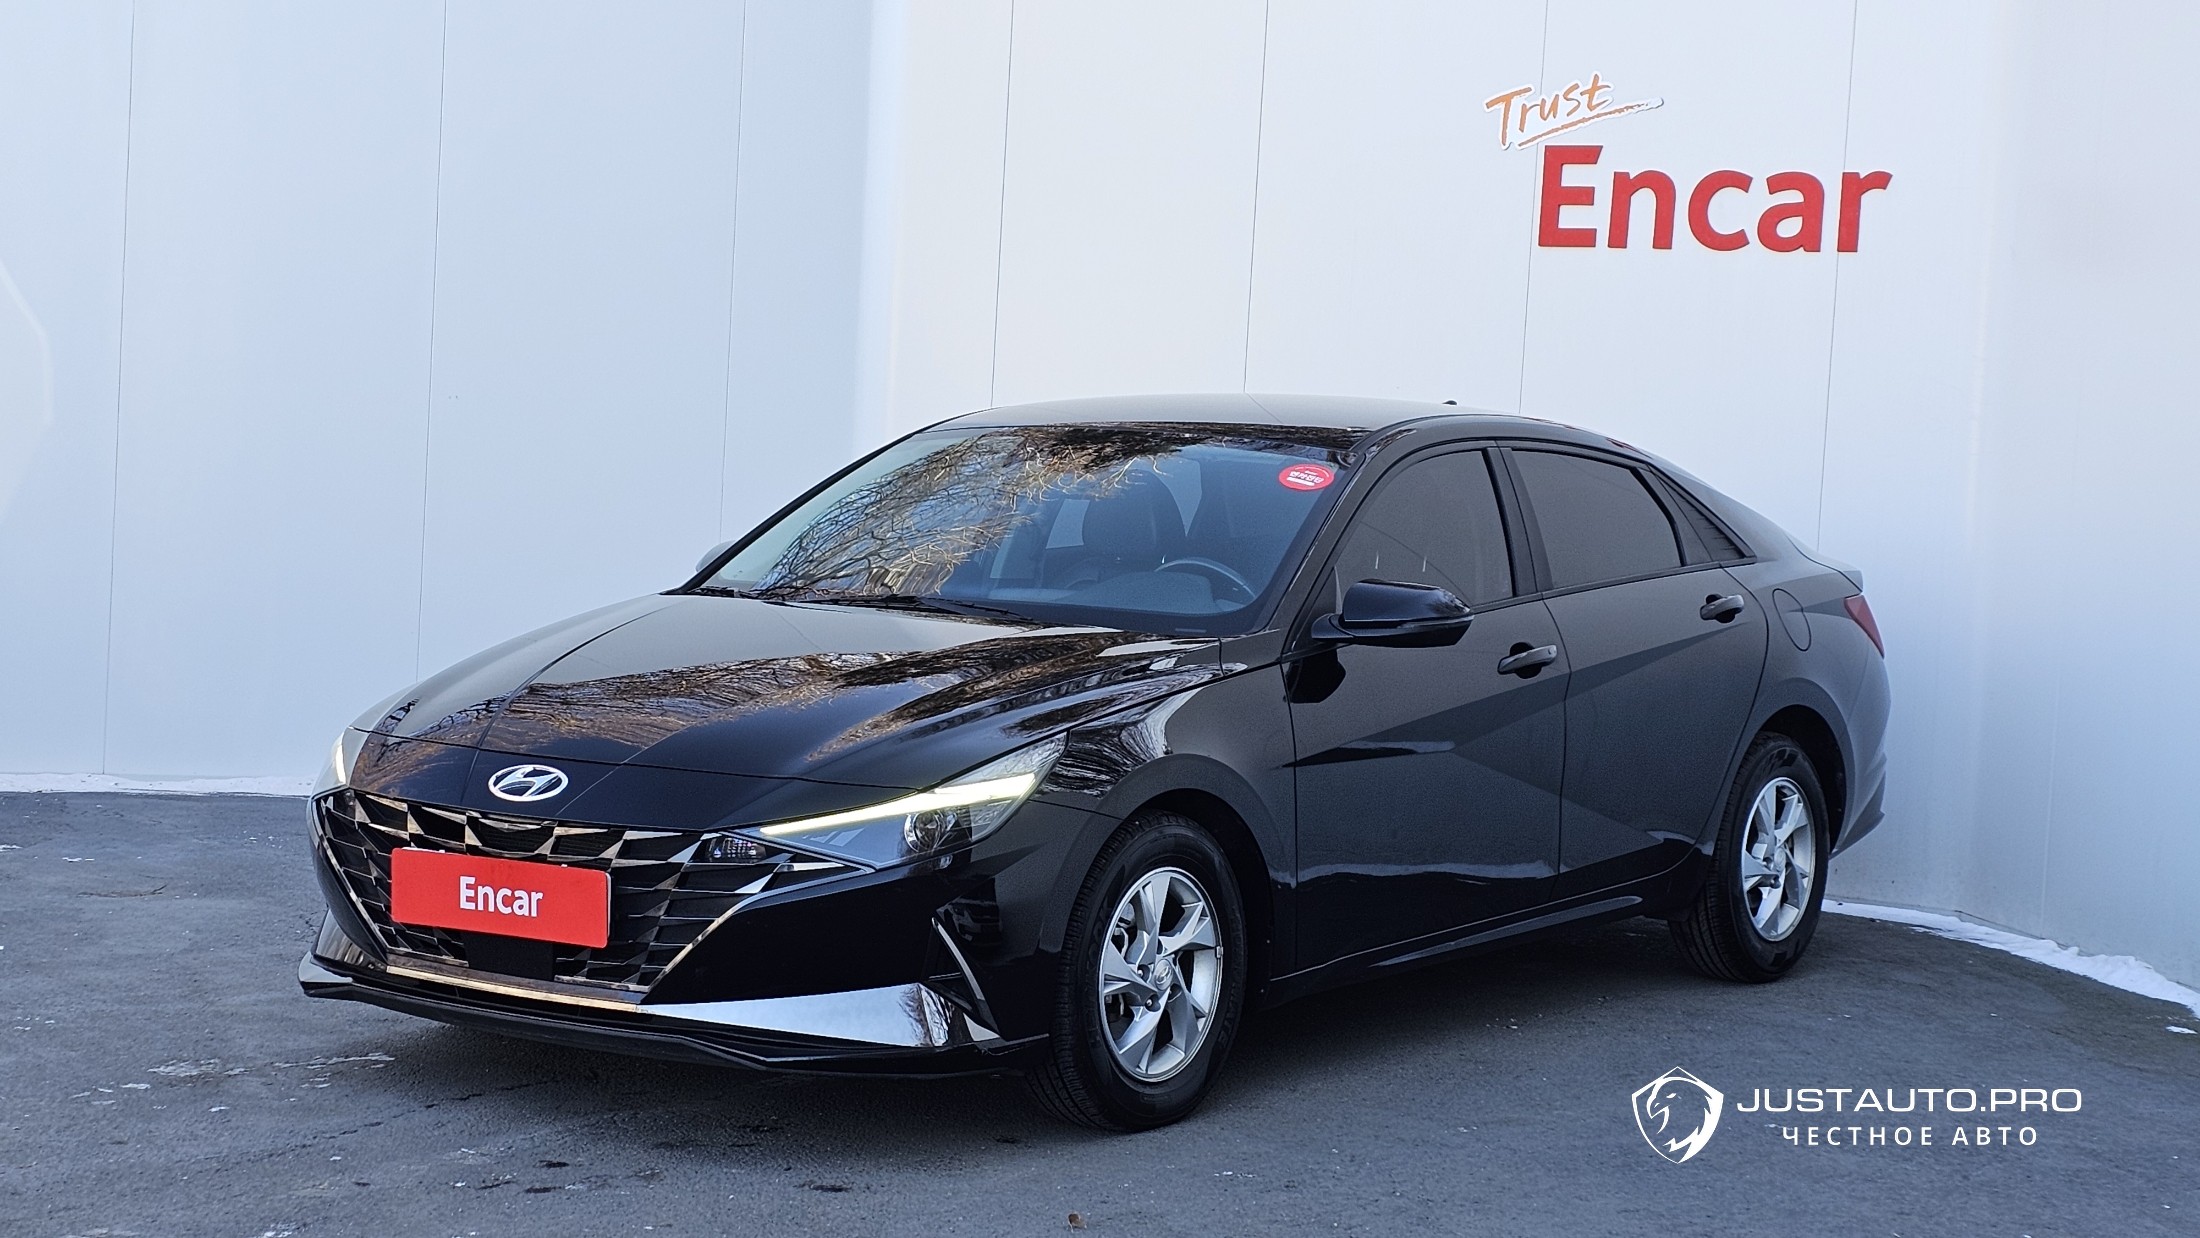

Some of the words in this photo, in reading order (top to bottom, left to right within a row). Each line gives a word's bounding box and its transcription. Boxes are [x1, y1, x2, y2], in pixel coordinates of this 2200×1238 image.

[1486, 73, 1612, 146] Trust
[1537, 144, 1893, 253] Encar
[459, 875, 544, 918] Encar
